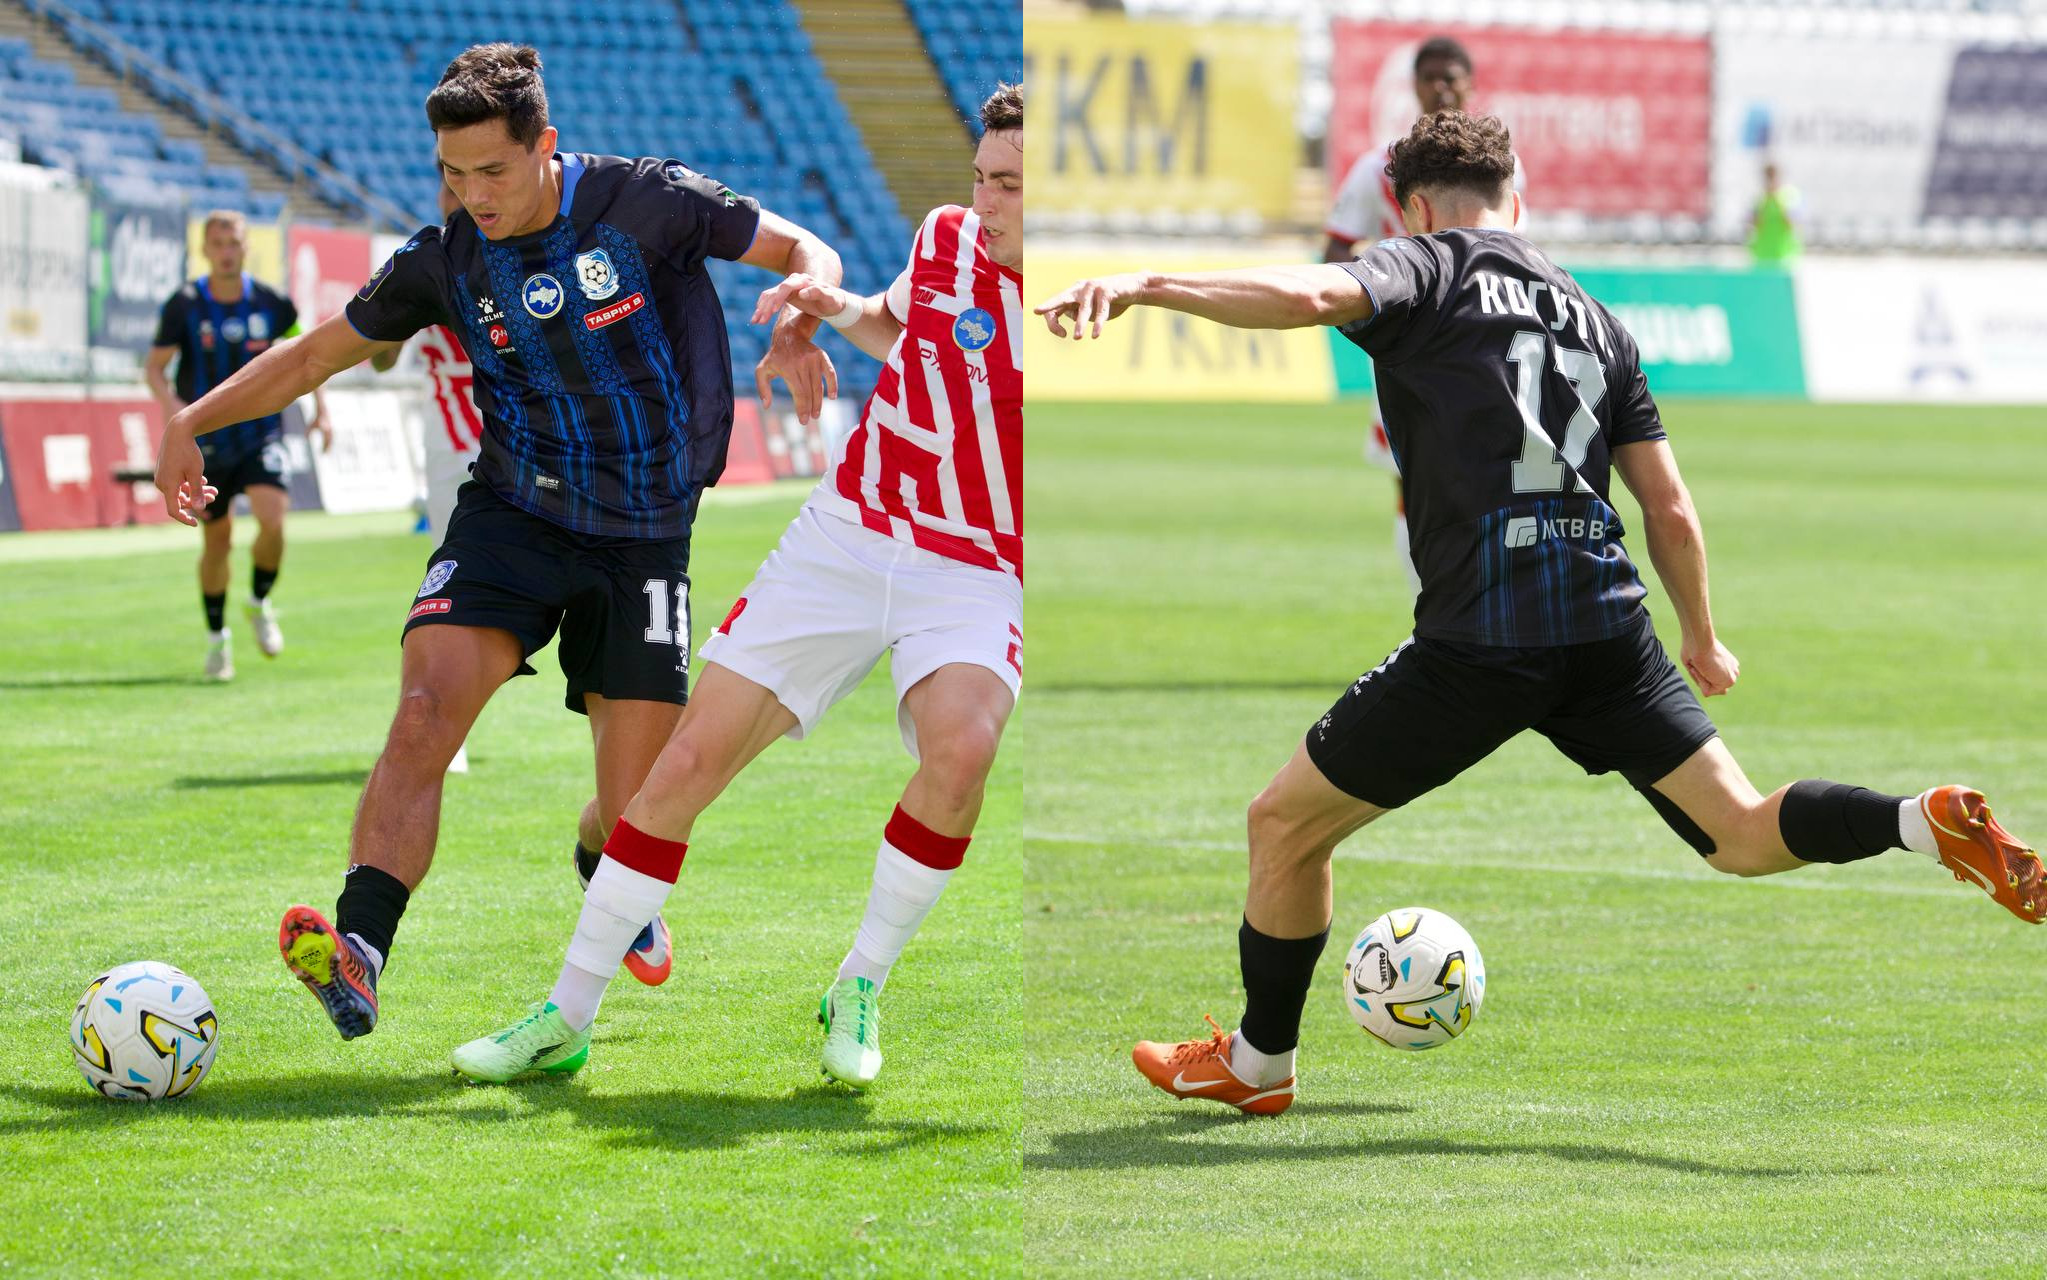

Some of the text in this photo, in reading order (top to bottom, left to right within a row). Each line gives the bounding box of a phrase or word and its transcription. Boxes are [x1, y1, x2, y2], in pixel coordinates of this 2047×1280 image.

[478, 311, 505, 324] KELME
[588, 302, 631, 325] ТАВРІЯ
[1475, 272, 1589, 340] КОГУТ
[1505, 329, 1607, 494] 17
[643, 578, 689, 650] 11
[1379, 951, 1388, 986] NITRO
